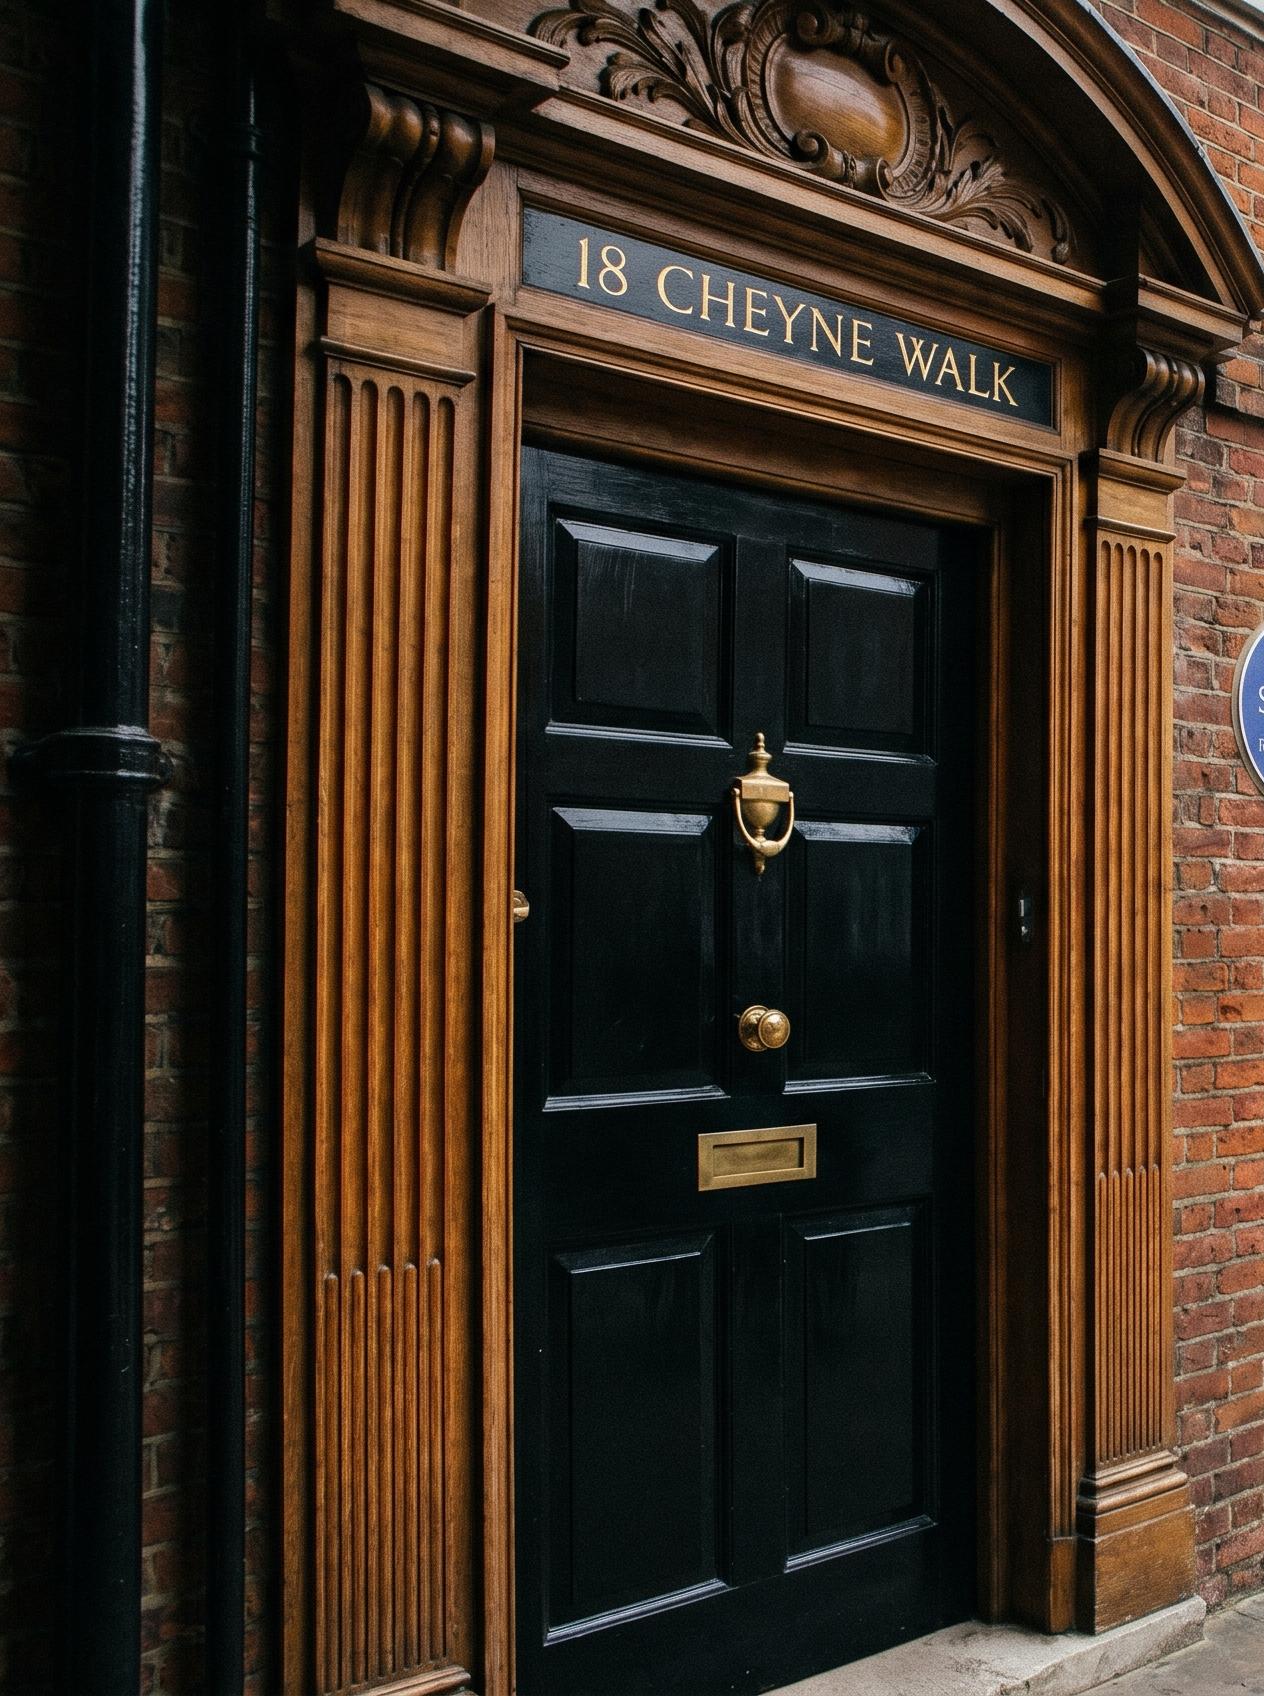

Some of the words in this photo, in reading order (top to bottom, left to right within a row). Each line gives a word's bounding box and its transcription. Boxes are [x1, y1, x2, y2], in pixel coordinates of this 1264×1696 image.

[577, 237, 628, 297] 18
[657, 265, 874, 367] CHEYNE
[895, 332, 1019, 407] WALK
